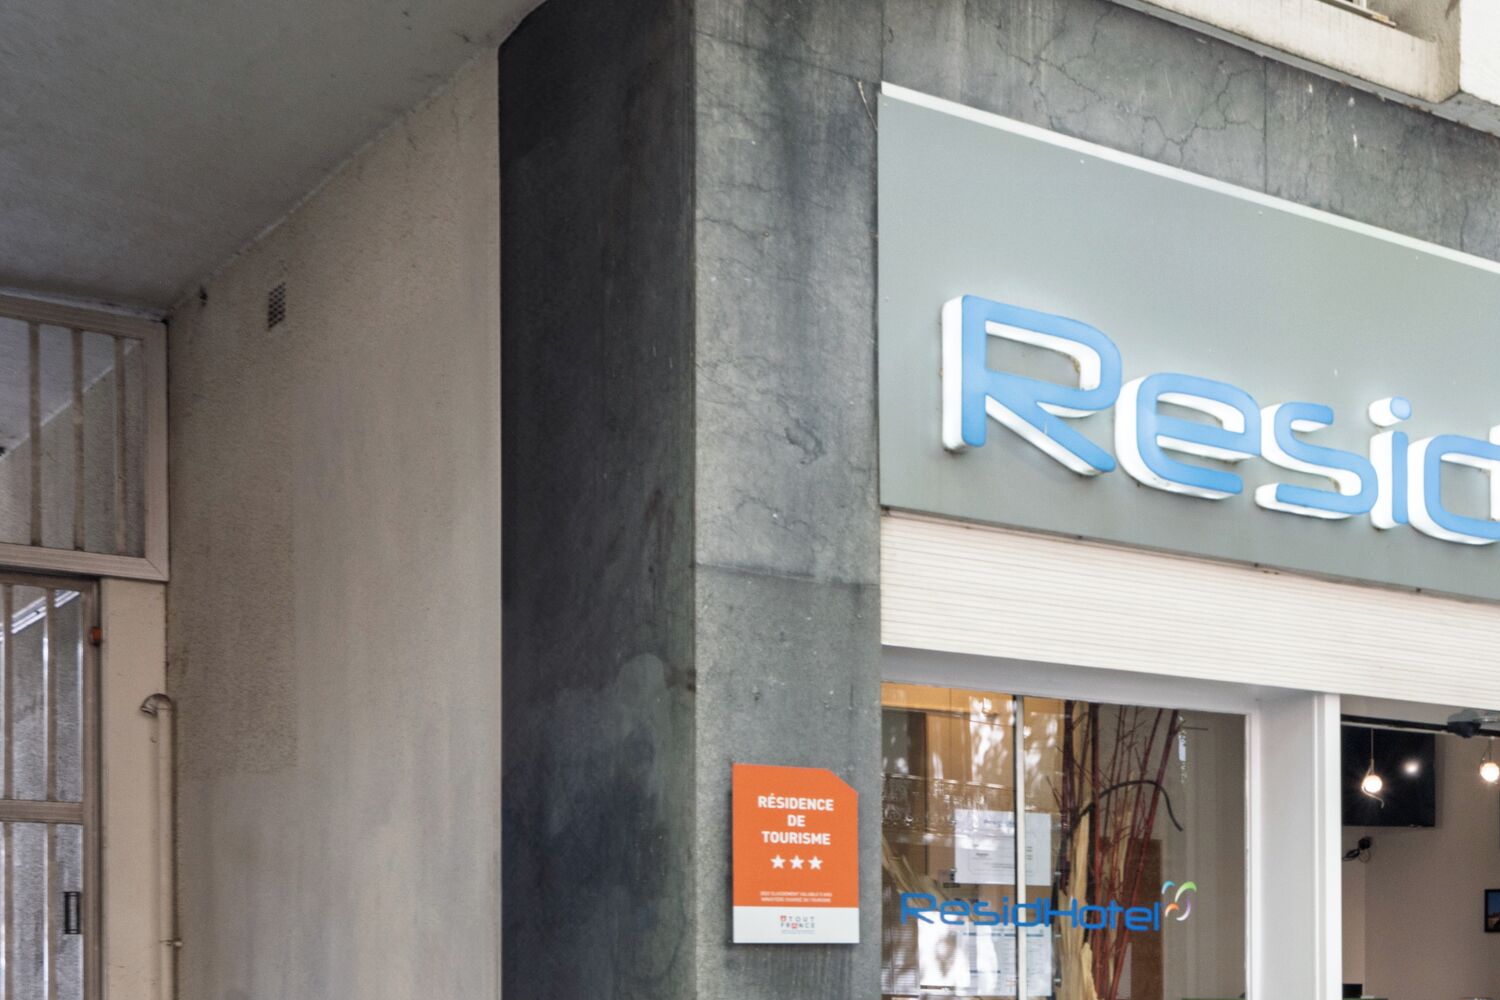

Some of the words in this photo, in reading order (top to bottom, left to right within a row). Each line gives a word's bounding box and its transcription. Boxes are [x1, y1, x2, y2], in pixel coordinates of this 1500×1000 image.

[758, 793, 834, 811] RÉSIDENCE
[787, 814, 806, 828] DE
[761, 830, 831, 845] TOURISME
[900, 892, 1160, 931] ResidHotel
